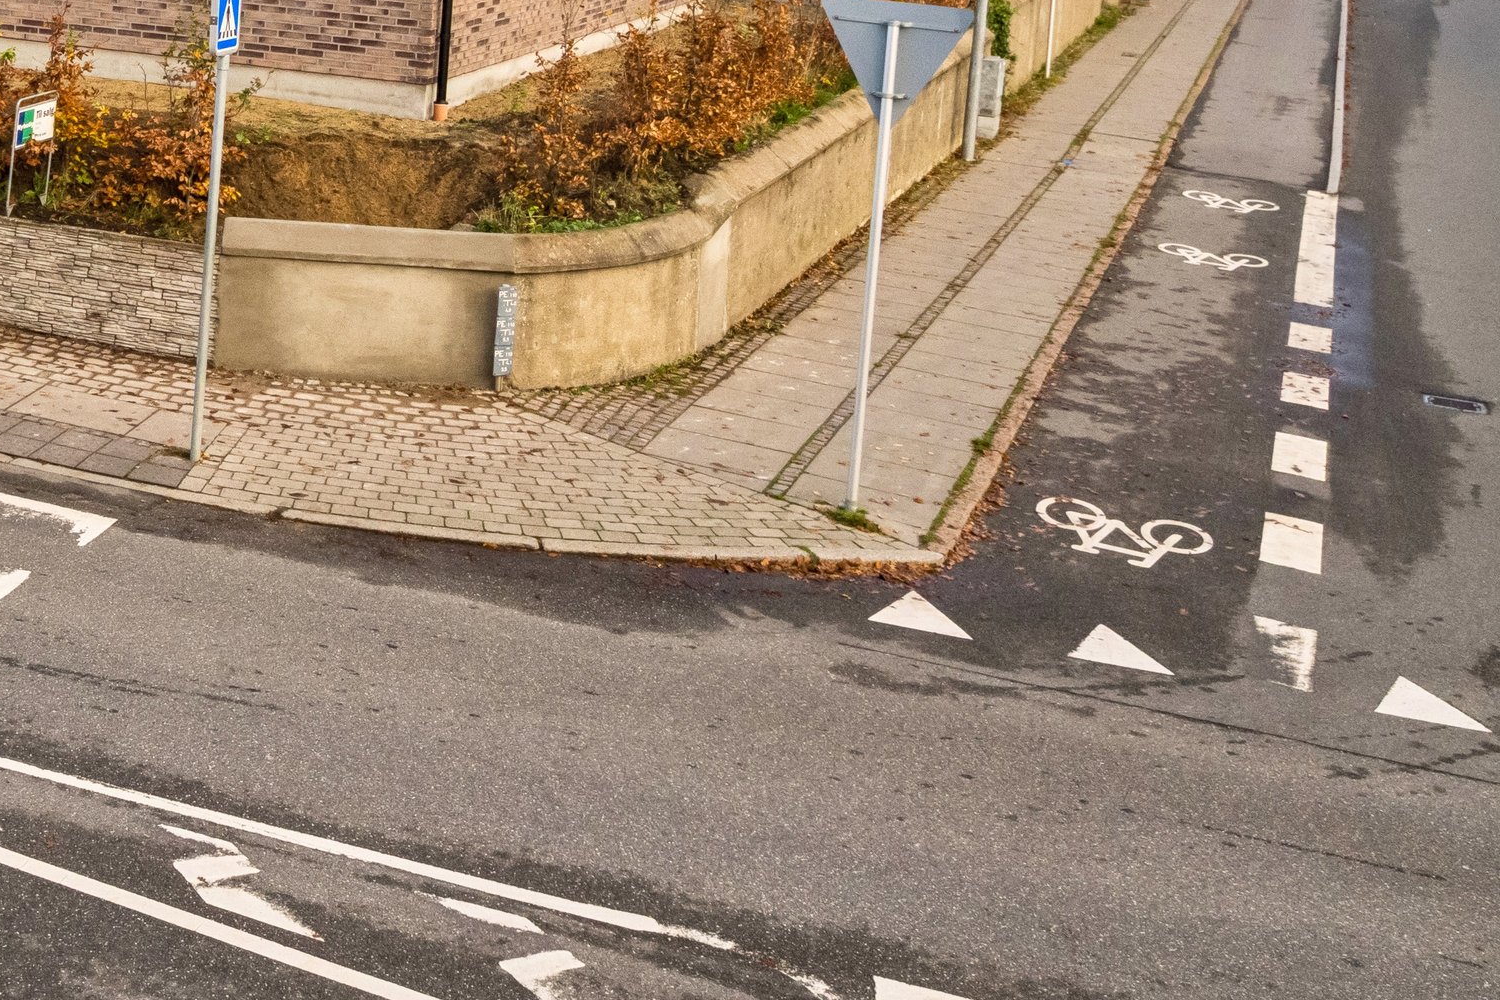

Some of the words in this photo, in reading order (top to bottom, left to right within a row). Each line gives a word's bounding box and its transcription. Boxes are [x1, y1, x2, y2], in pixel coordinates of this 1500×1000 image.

[499, 290, 509, 298] PE
[496, 320, 506, 328] PE
[494, 350, 504, 358] PE
